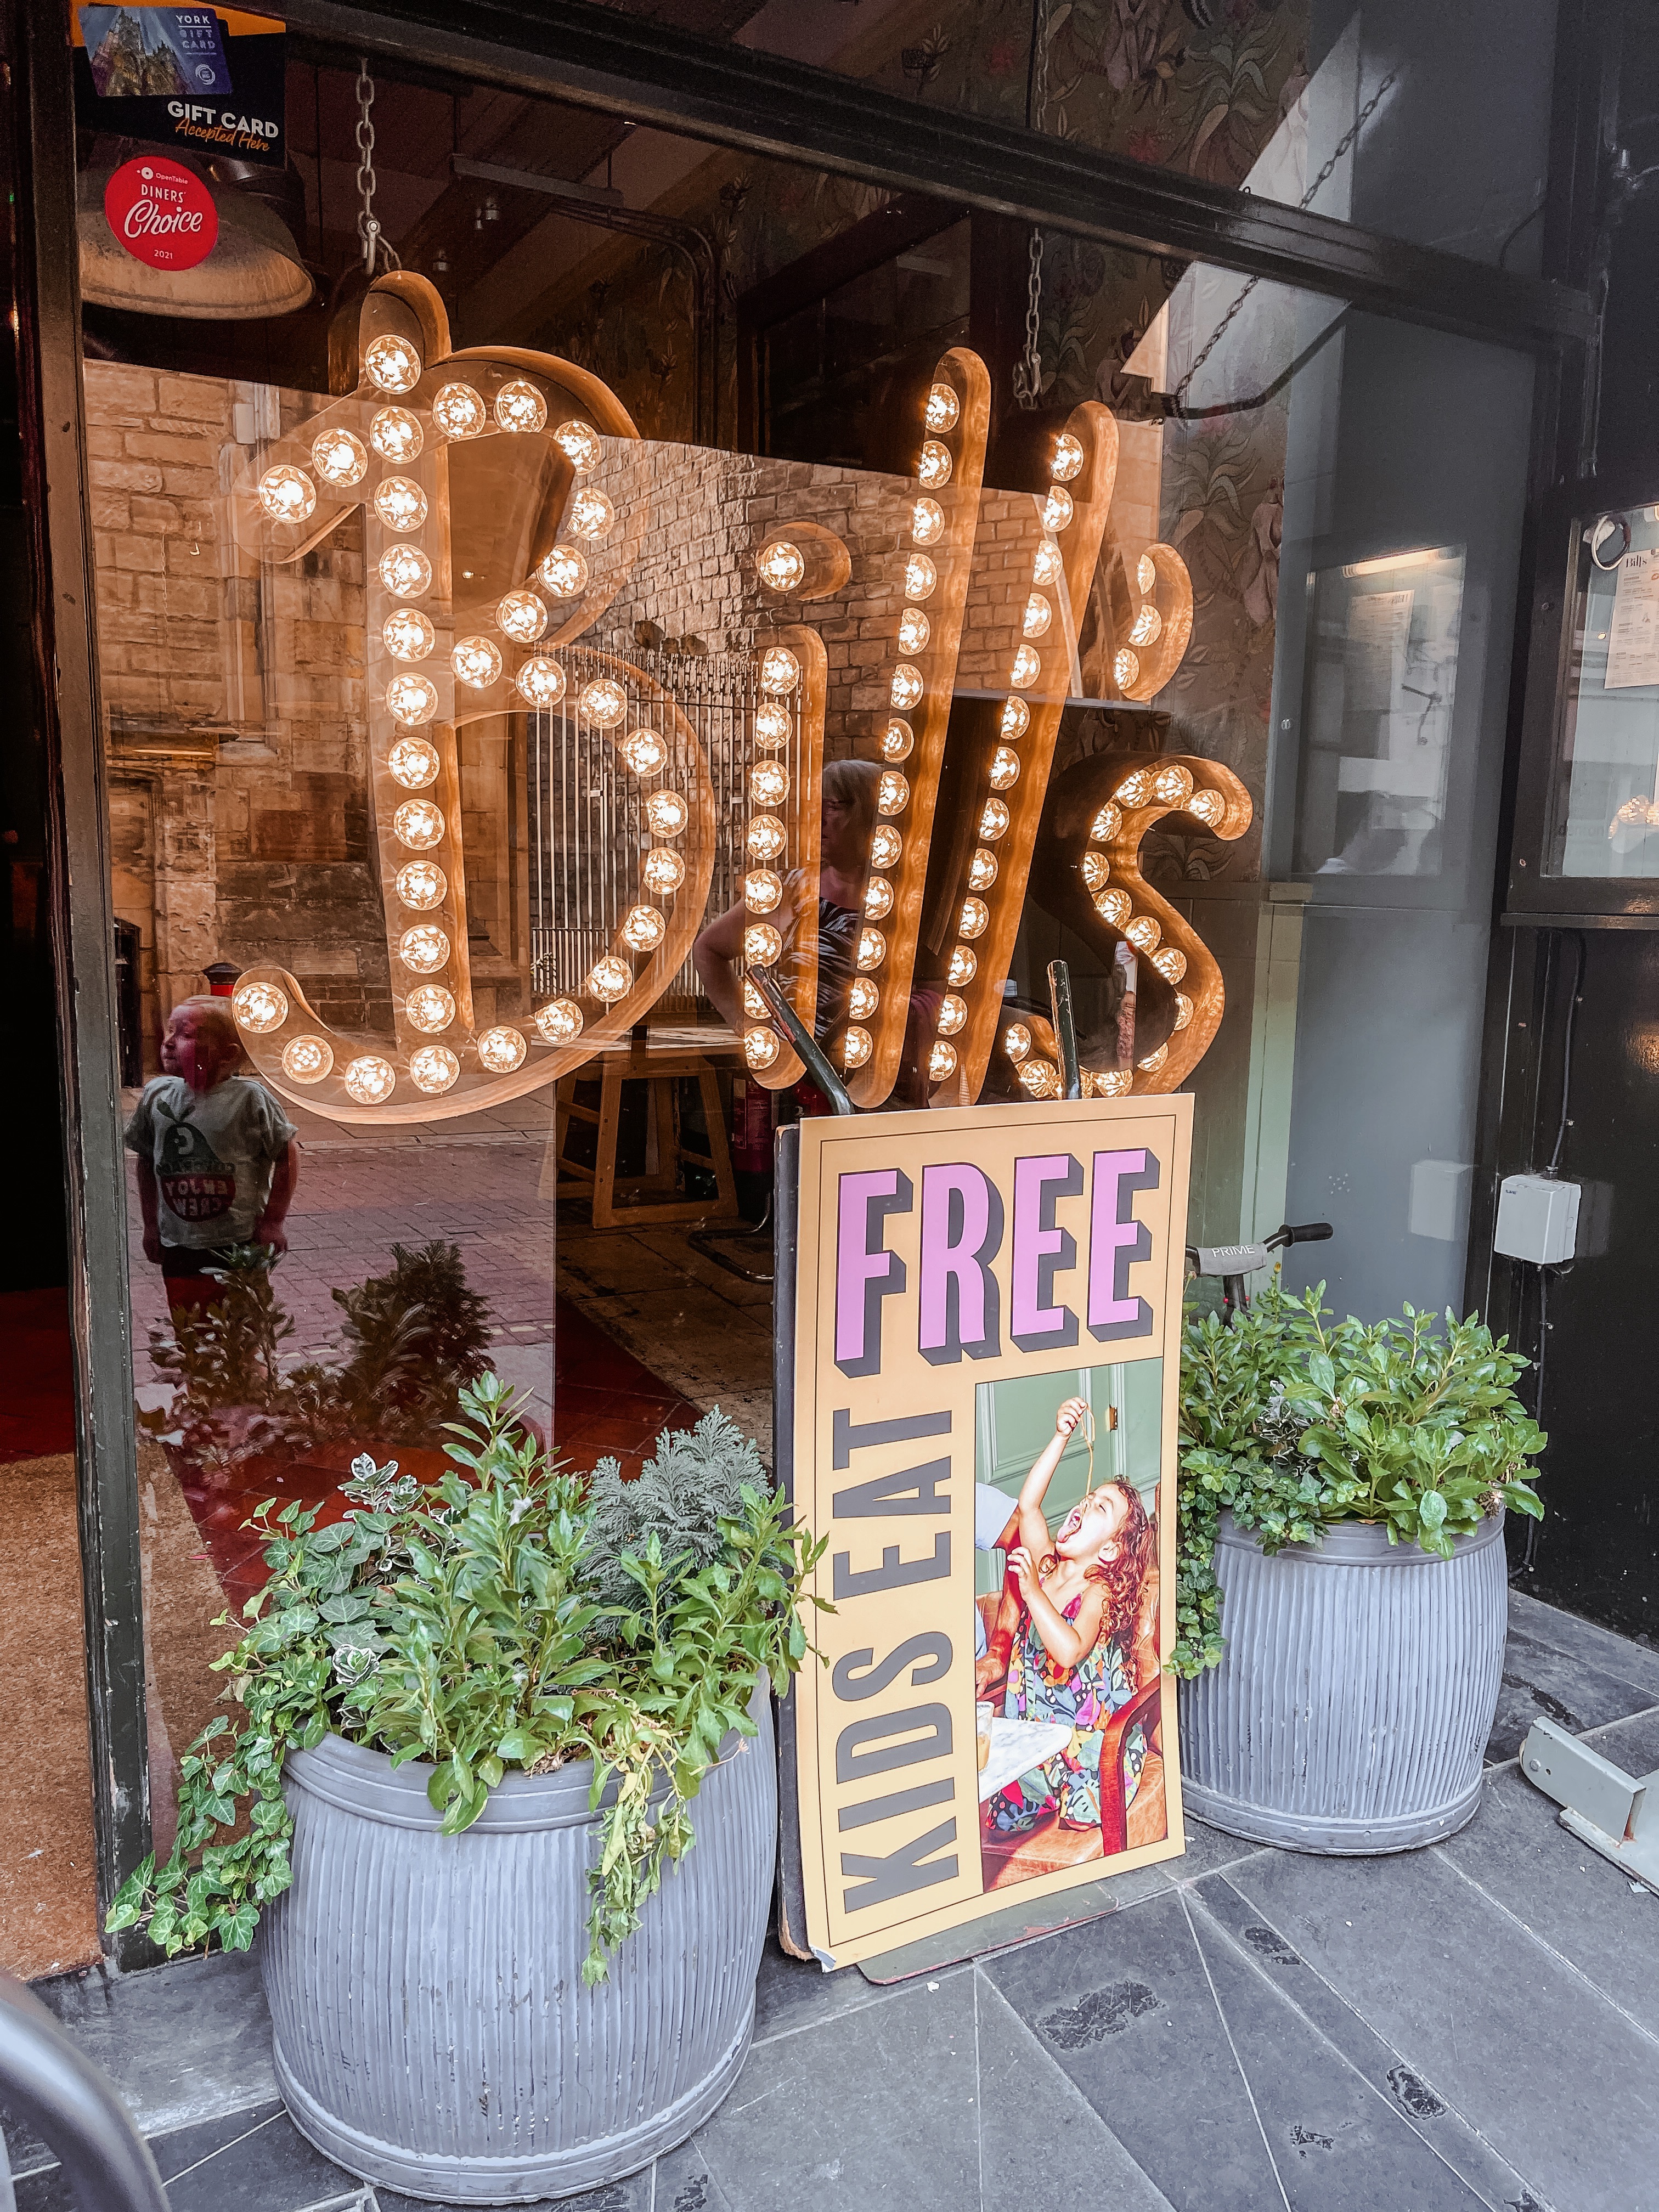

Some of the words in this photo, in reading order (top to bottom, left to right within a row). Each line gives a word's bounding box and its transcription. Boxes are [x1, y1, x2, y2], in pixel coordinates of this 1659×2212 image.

[176, 15, 210, 24] YORK
[179, 29, 212, 38] GIFT
[182, 40, 216, 49] CARD
[167, 101, 216, 124] GIFT
[221, 112, 279, 137] CARD
[175, 117, 238, 146] Accepted
[239, 131, 270, 151] Here
[156, 173, 188, 184] OpenTable
[124, 199, 203, 238] Choice
[154, 249, 173, 259] 2021
[1211, 1245, 1255, 1257] PRIME
[834, 1147, 1160, 1379] FREE
[833, 1407, 952, 1601] EAT
[832, 1630, 959, 1914] KIDS
